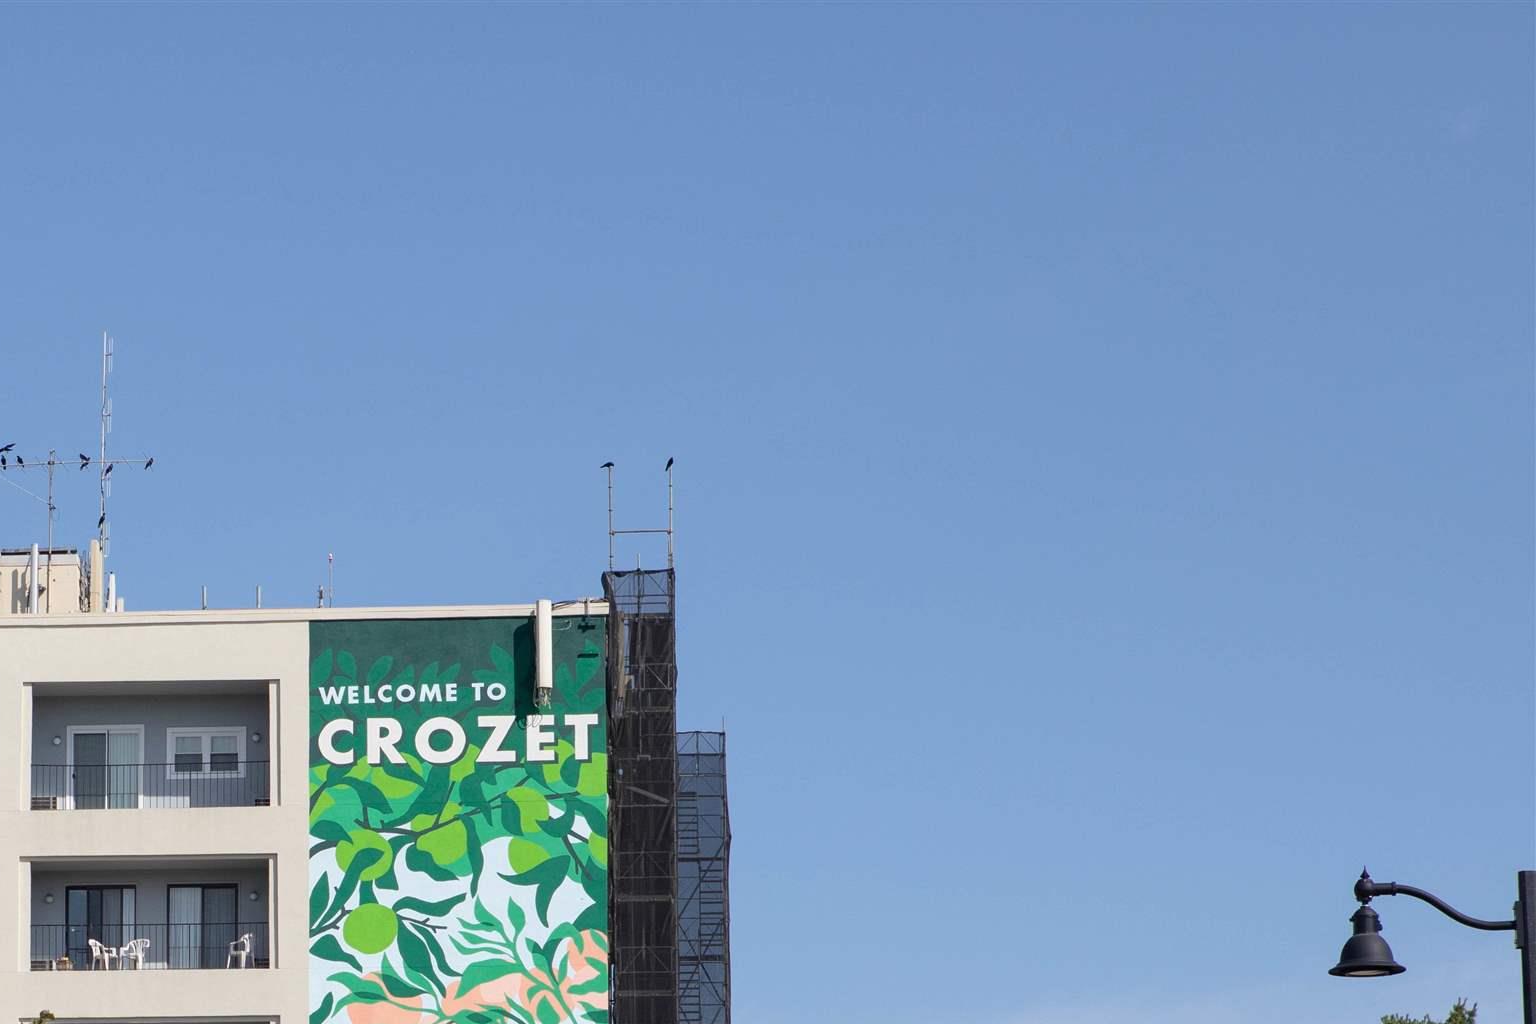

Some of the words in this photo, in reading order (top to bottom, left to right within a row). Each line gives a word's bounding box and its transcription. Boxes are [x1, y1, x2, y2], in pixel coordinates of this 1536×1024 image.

[318, 683, 457, 705] WELCOME
[471, 682, 507, 701] TO
[317, 713, 599, 765] CROZET
